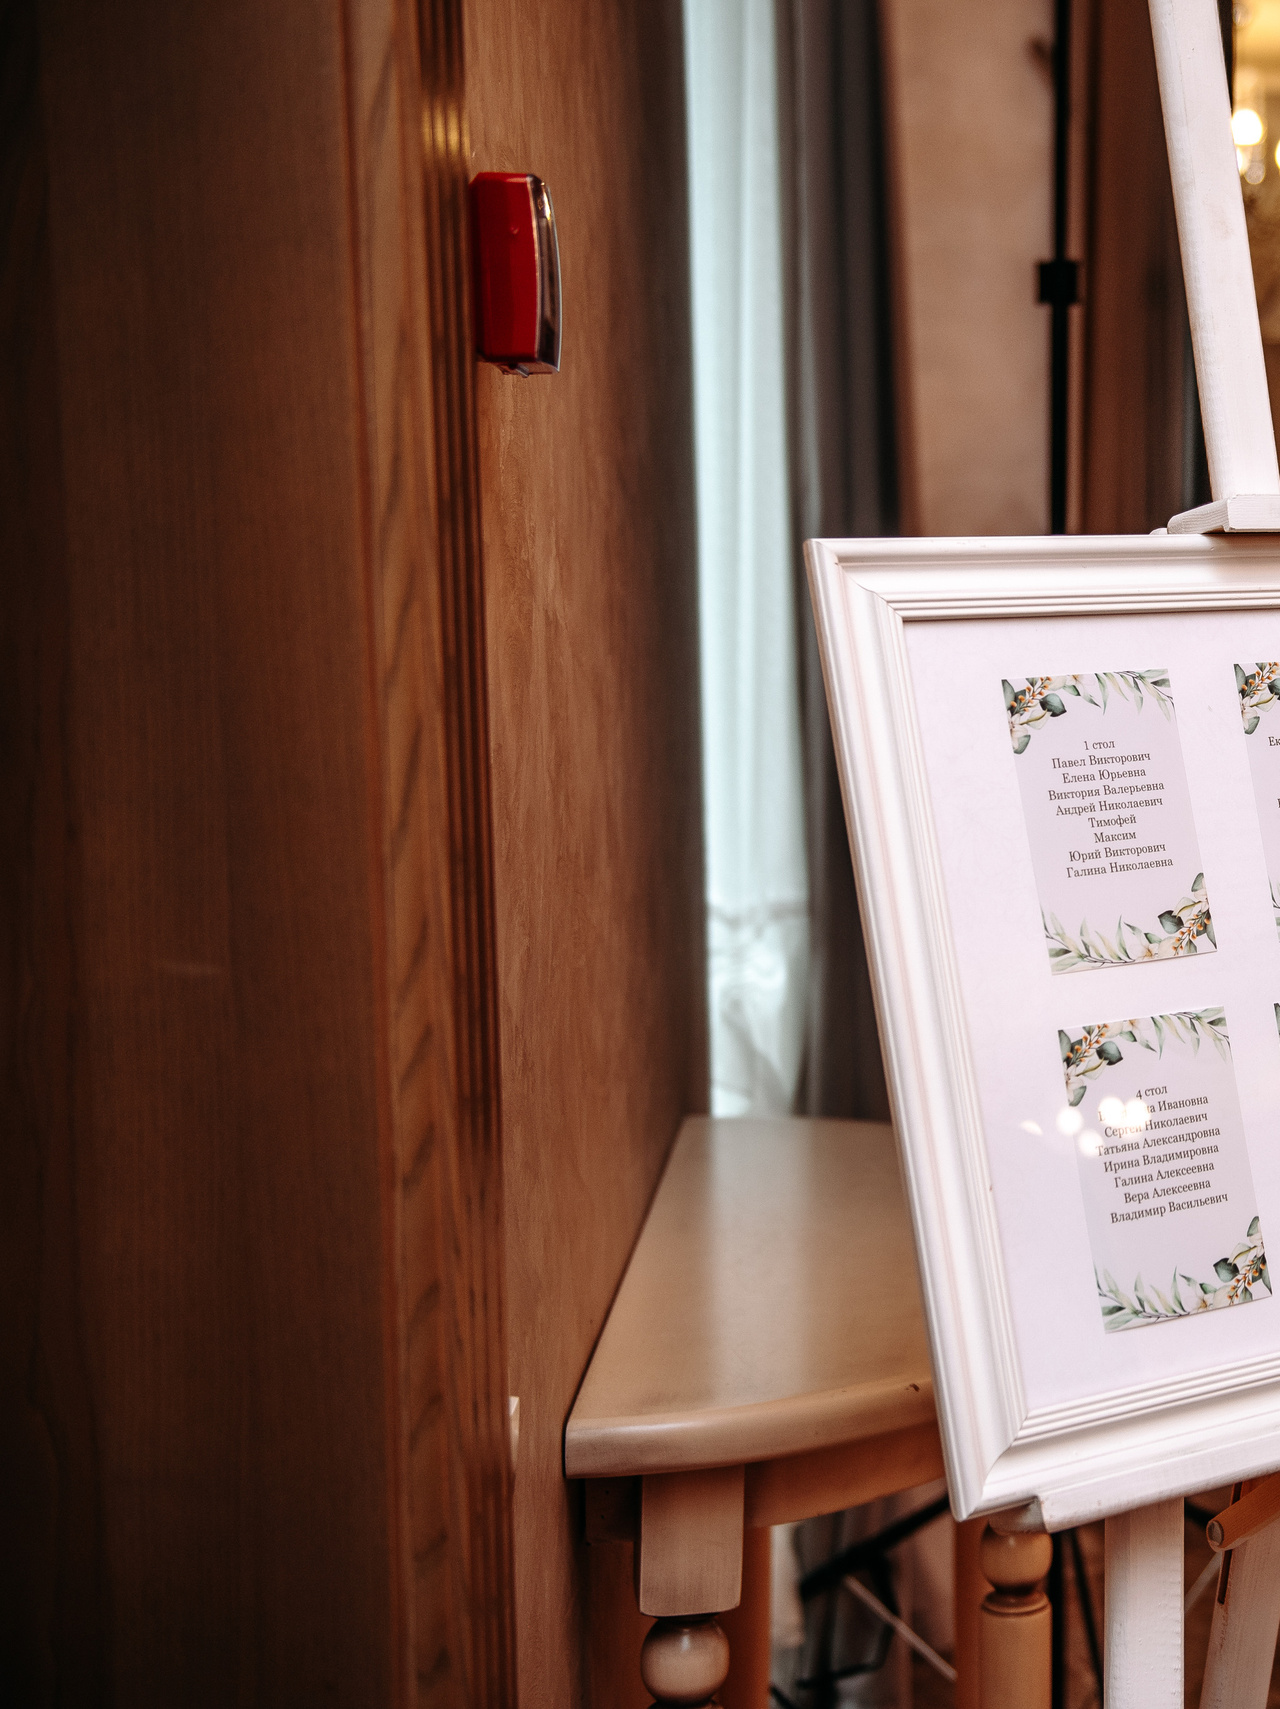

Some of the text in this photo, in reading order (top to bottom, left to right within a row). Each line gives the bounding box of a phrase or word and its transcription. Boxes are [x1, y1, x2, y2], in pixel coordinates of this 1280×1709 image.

[1084, 740, 1115, 750] 1 стол
[1052, 752, 1151, 769] Павел Викторович
[1062, 768, 1147, 784] Елена Юрьевна
[1048, 781, 1165, 801] Виктория Валерьевна
[1056, 797, 1163, 816] Андрей Николаевич
[1088, 814, 1137, 828] Тимофей
[1094, 831, 1137, 843] Максим
[1069, 843, 1166, 863] Юрий Викторович
[1066, 858, 1174, 878] Галина Николаевна
[1135, 1086, 1168, 1100] 4 стол
[1157, 1095, 1209, 1112] Ивановна
[1145, 1112, 1208, 1131] Николаевич
[1095, 1127, 1221, 1157] Татьяна Александровна
[1103, 1144, 1219, 1173] Ирина Владимировна
[1114, 1162, 1215, 1188] Галина Алексеевна
[1124, 1179, 1211, 1204] Вера Алексеевна
[1110, 1193, 1228, 1224] Владимир Васильевич
